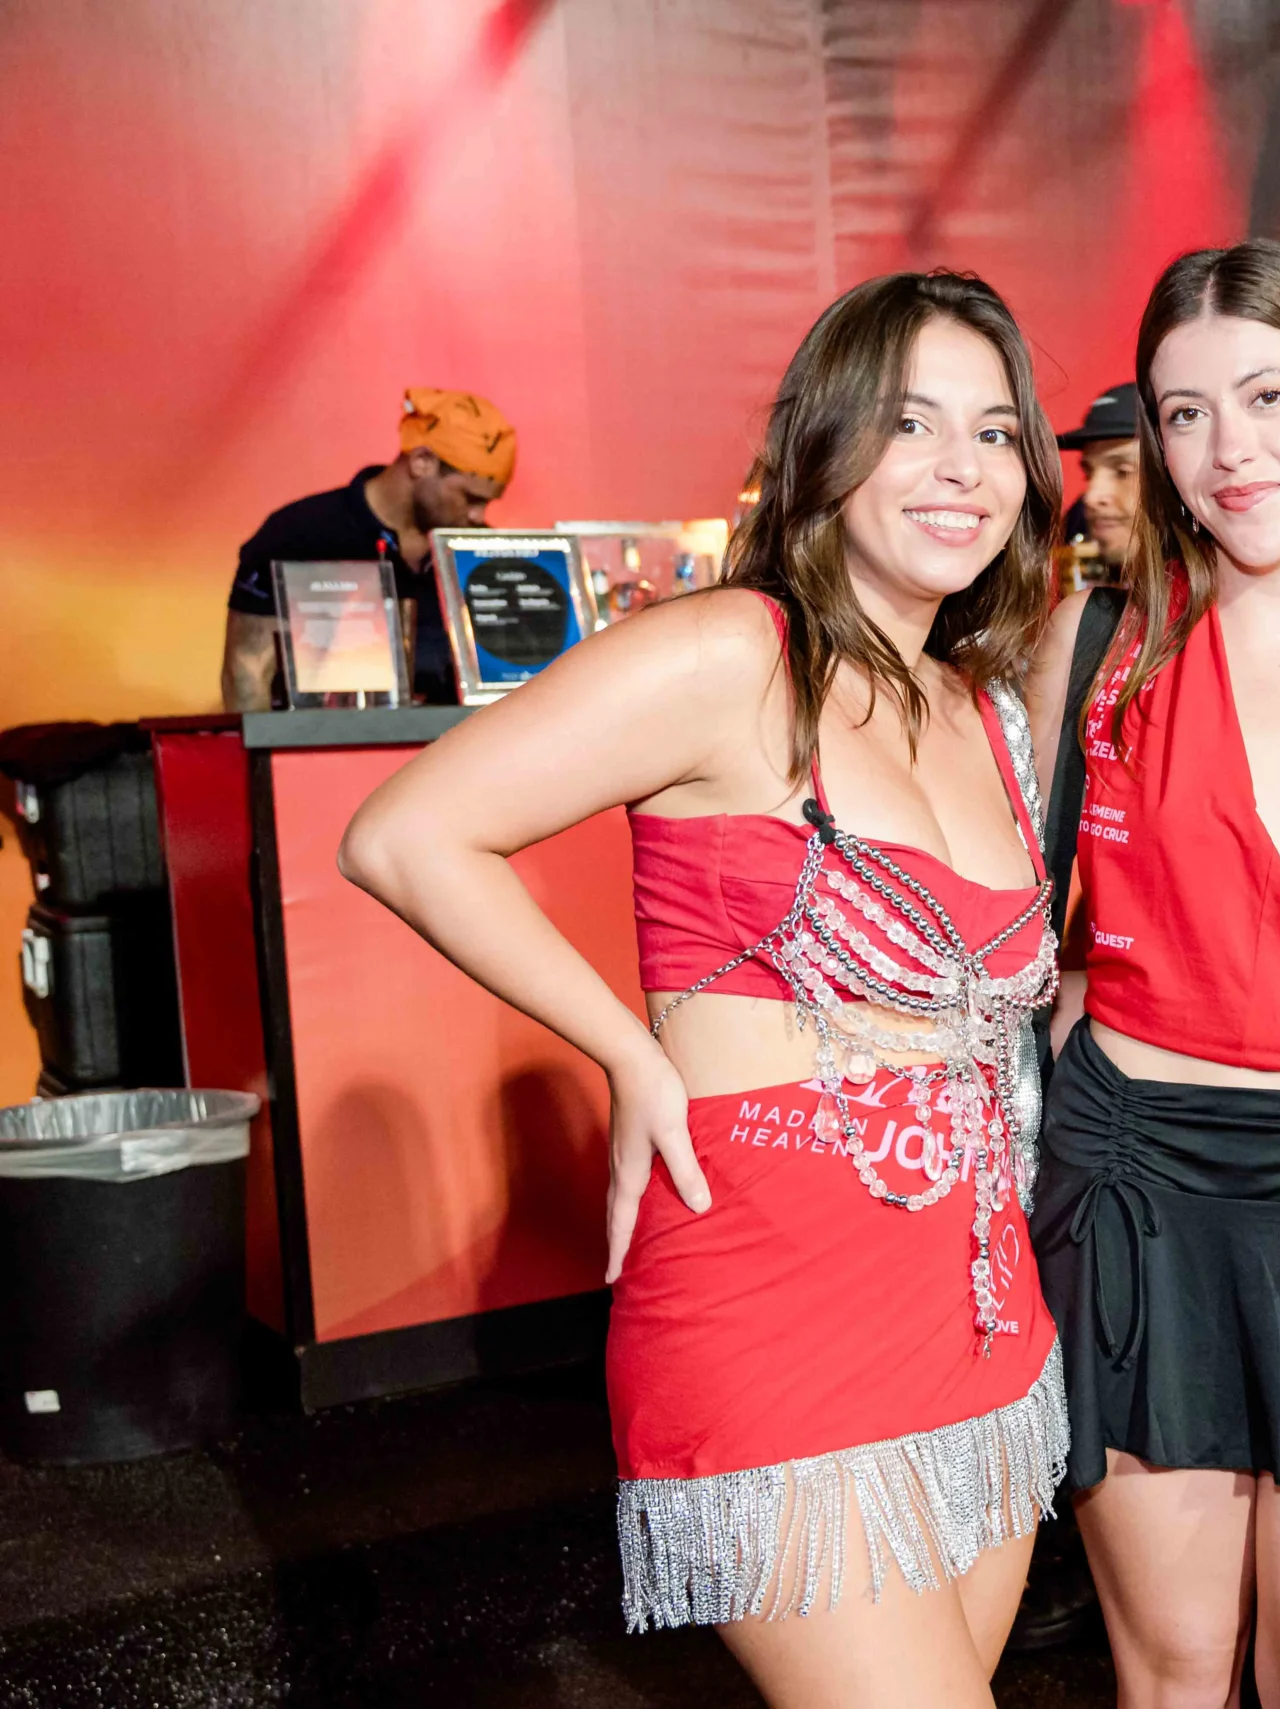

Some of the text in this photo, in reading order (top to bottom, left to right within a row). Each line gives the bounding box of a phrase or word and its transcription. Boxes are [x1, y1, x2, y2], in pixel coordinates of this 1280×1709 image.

[1103, 827, 1130, 844] CRUZ
[1095, 931, 1134, 950] GUEST
[730, 1123, 849, 1157] HEAVEN
